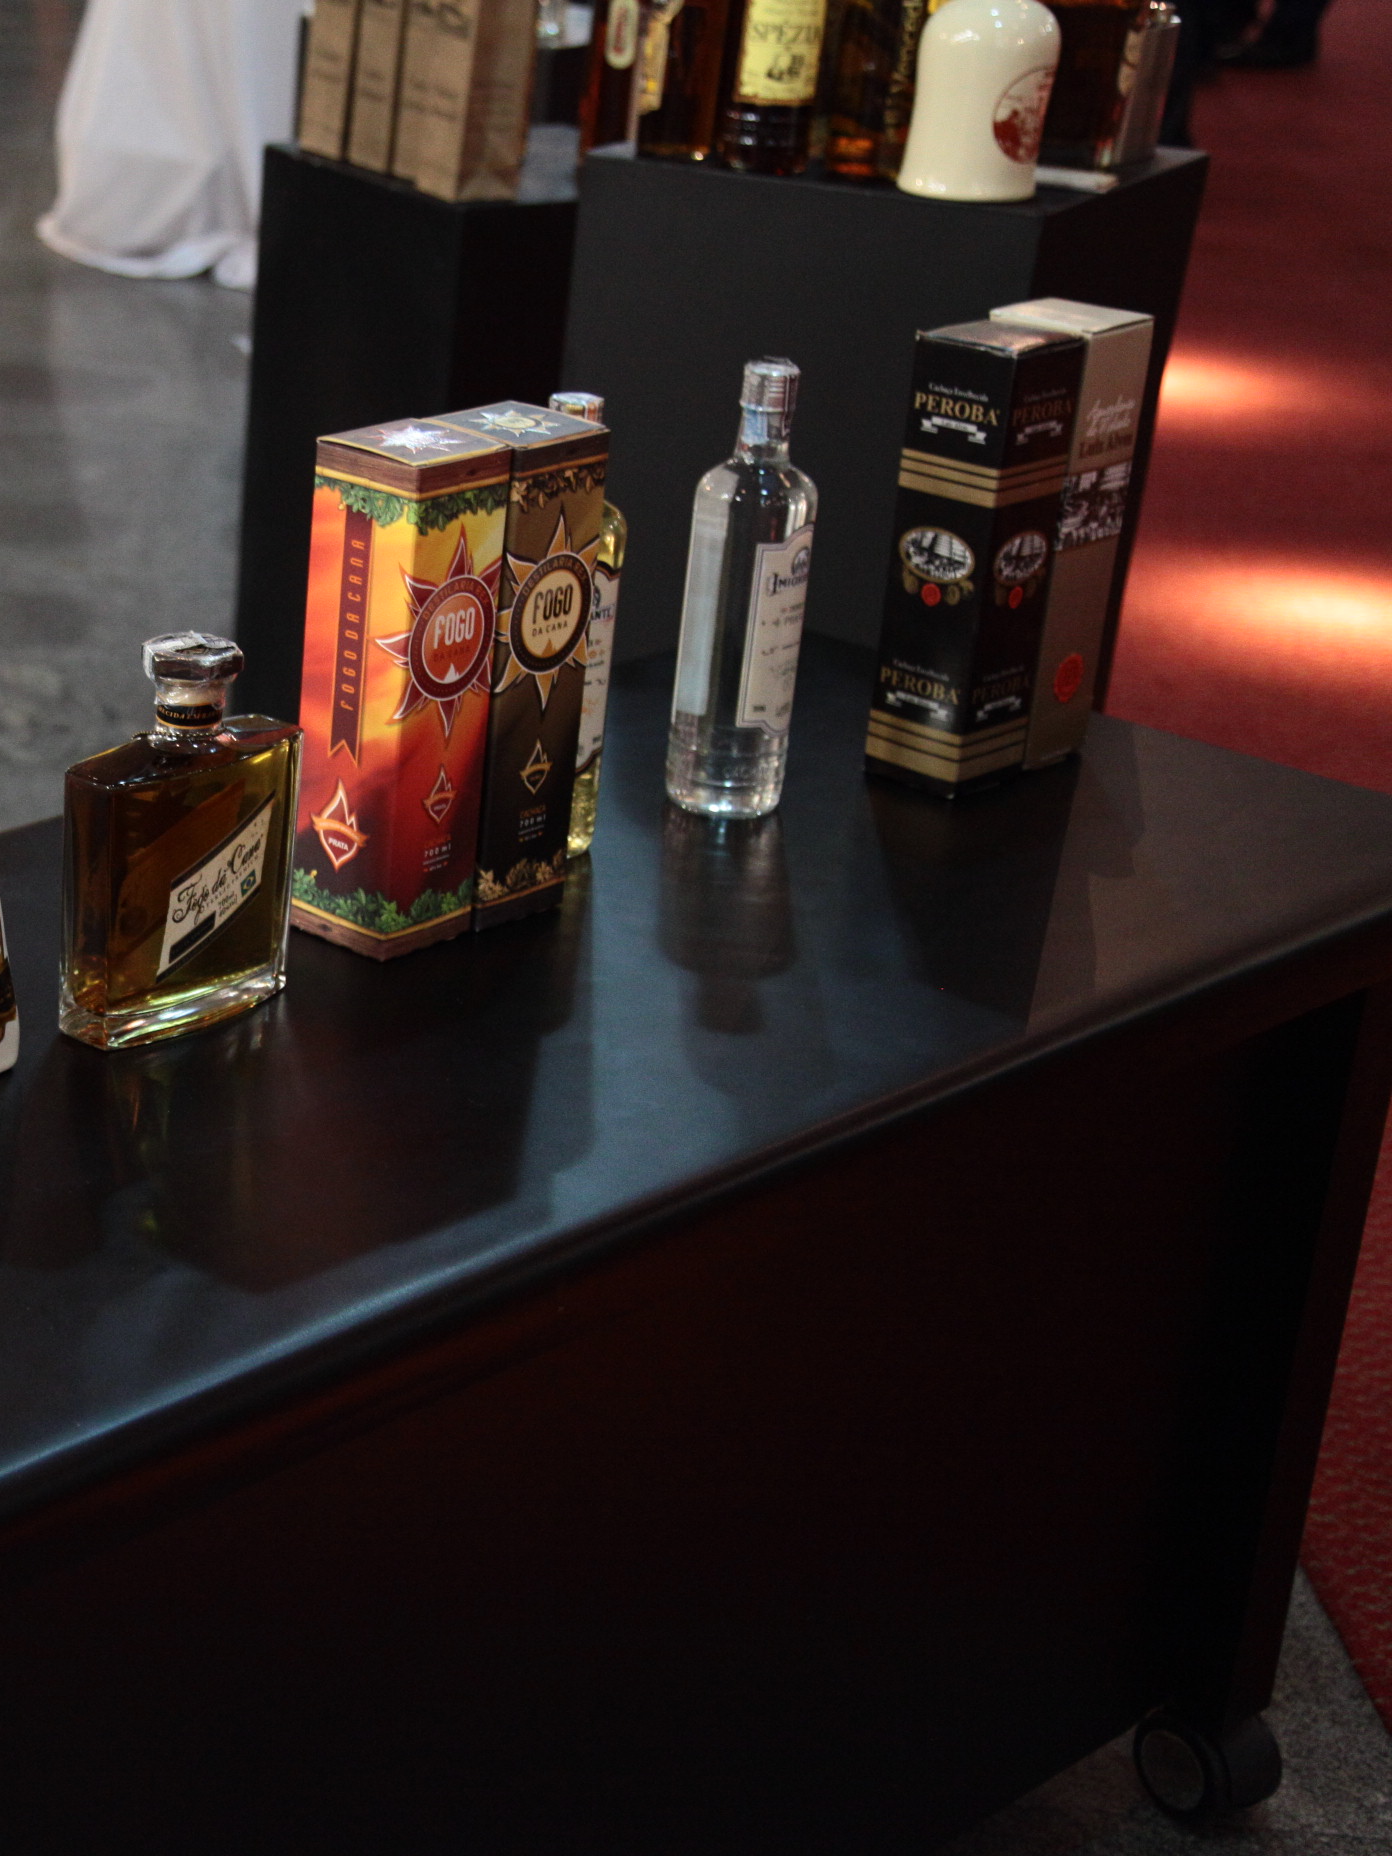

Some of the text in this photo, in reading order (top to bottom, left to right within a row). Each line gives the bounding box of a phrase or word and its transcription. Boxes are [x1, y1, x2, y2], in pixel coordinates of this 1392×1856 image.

[914, 391, 998, 427] PEROBA
[533, 584, 573, 625] FOGO
[433, 607, 475, 649] FOGO
[532, 620, 568, 638] DA CANA
[880, 666, 958, 705] PEROBA
[328, 837, 348, 851] PRATA
